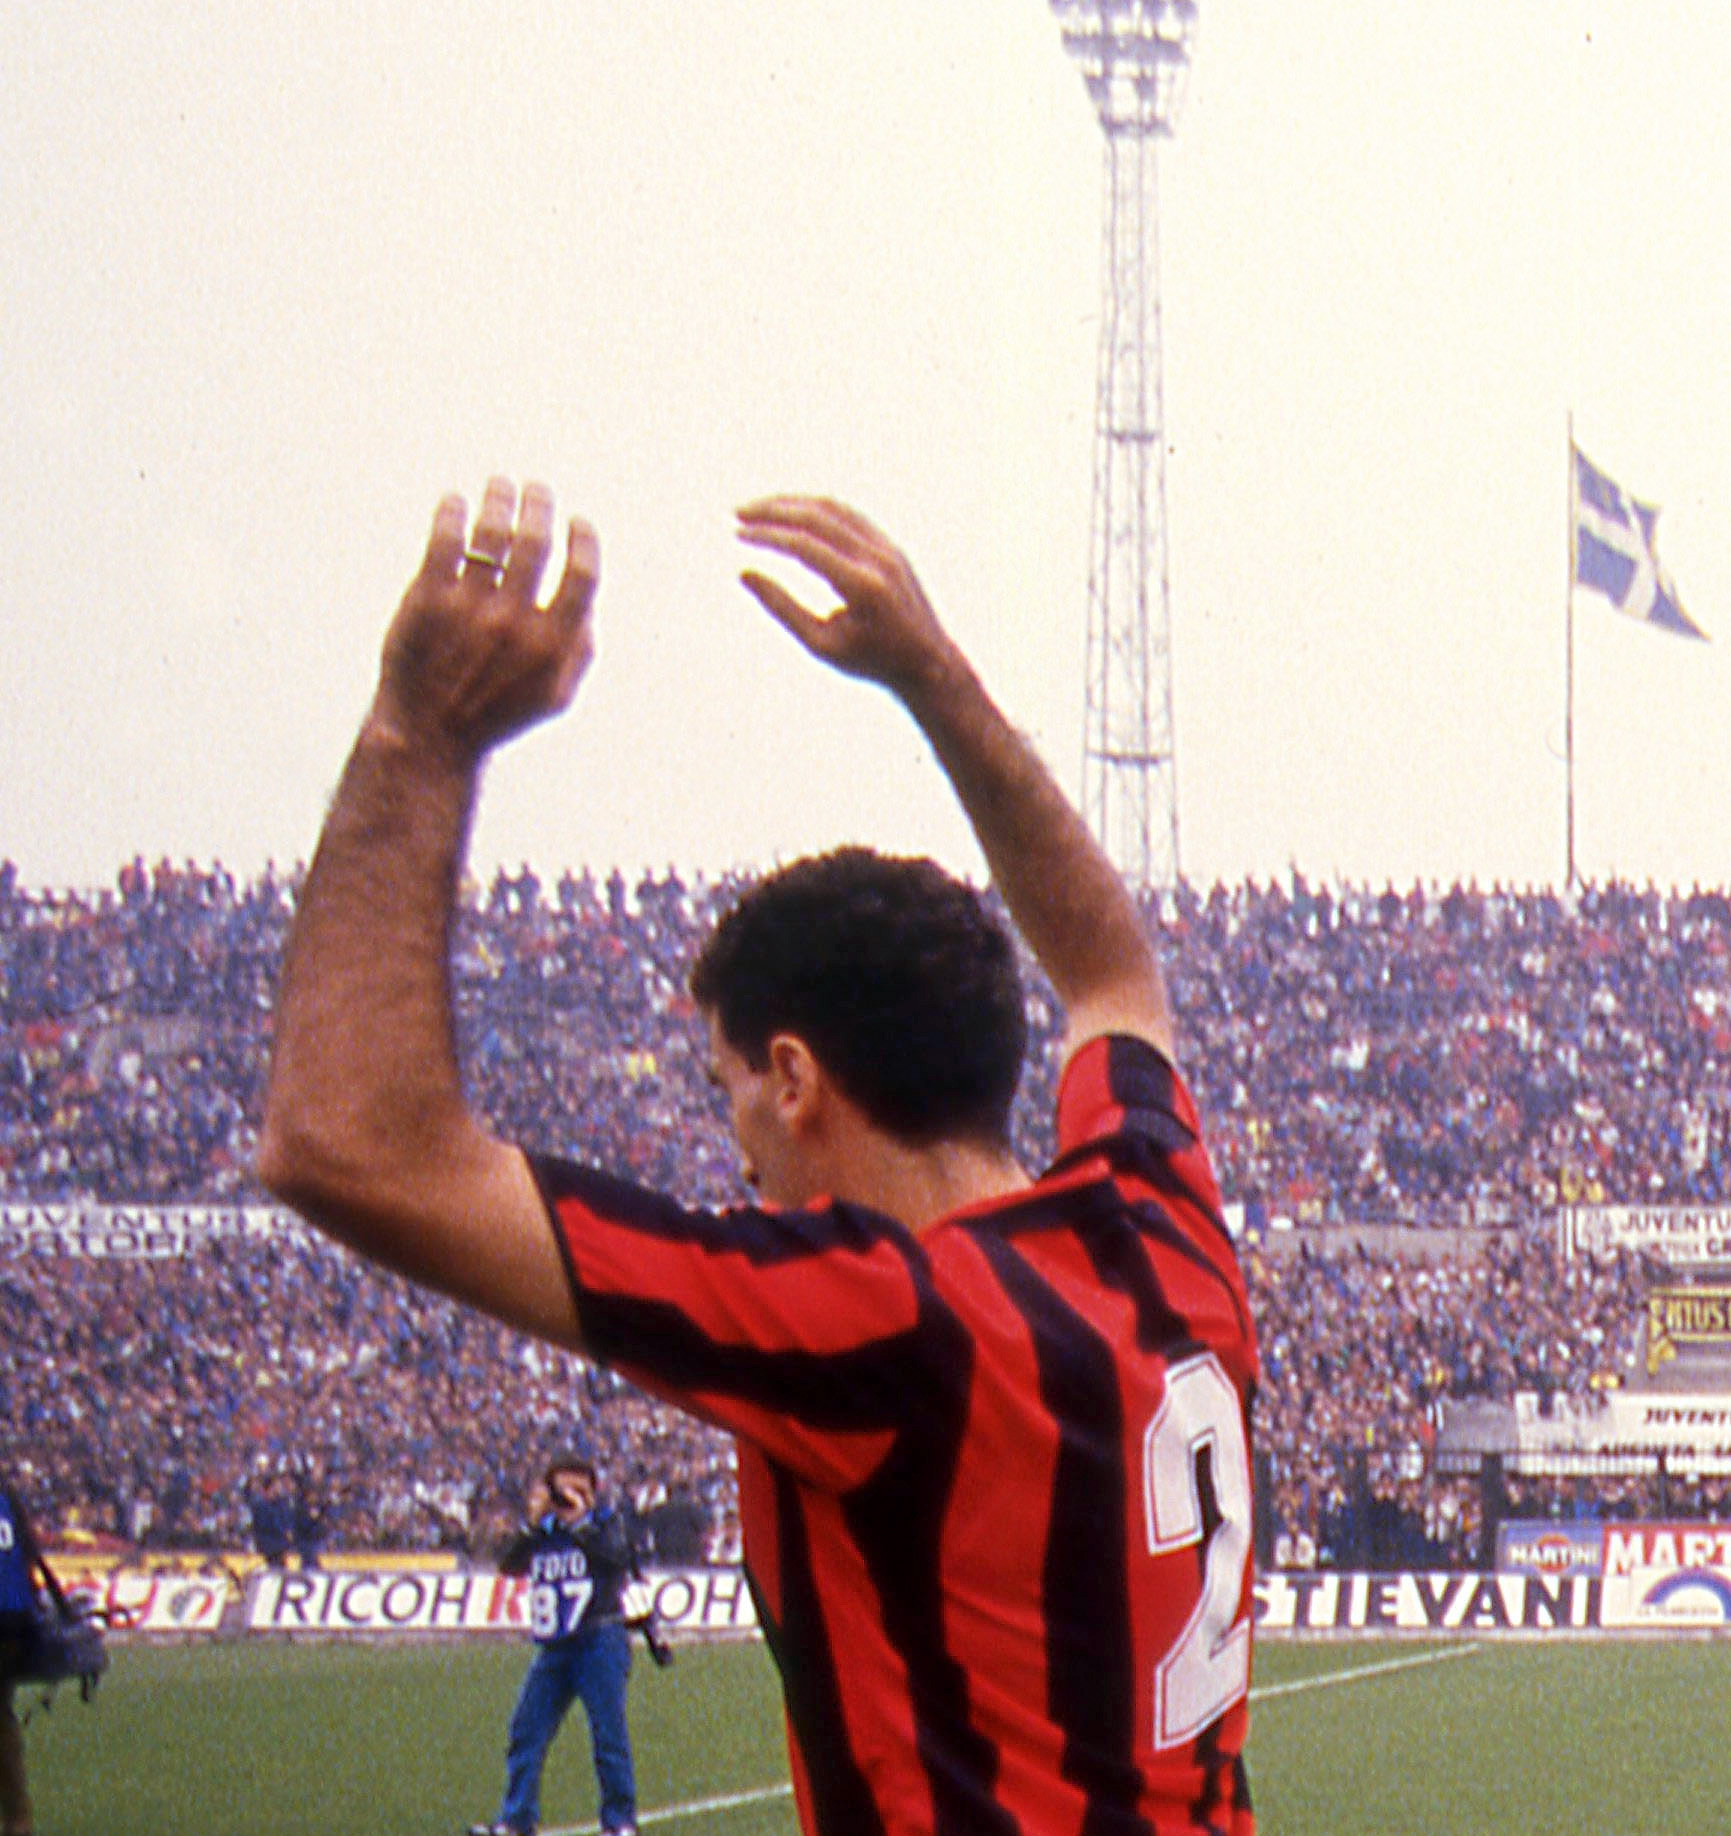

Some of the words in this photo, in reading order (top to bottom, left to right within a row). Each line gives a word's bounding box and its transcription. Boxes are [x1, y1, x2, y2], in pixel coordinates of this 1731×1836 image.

[1144, 1352, 1252, 1750] 2
[1508, 1544, 1599, 1568] MARTINI
[270, 1573, 473, 1625] RICOH
[531, 1577, 594, 1639] 87
